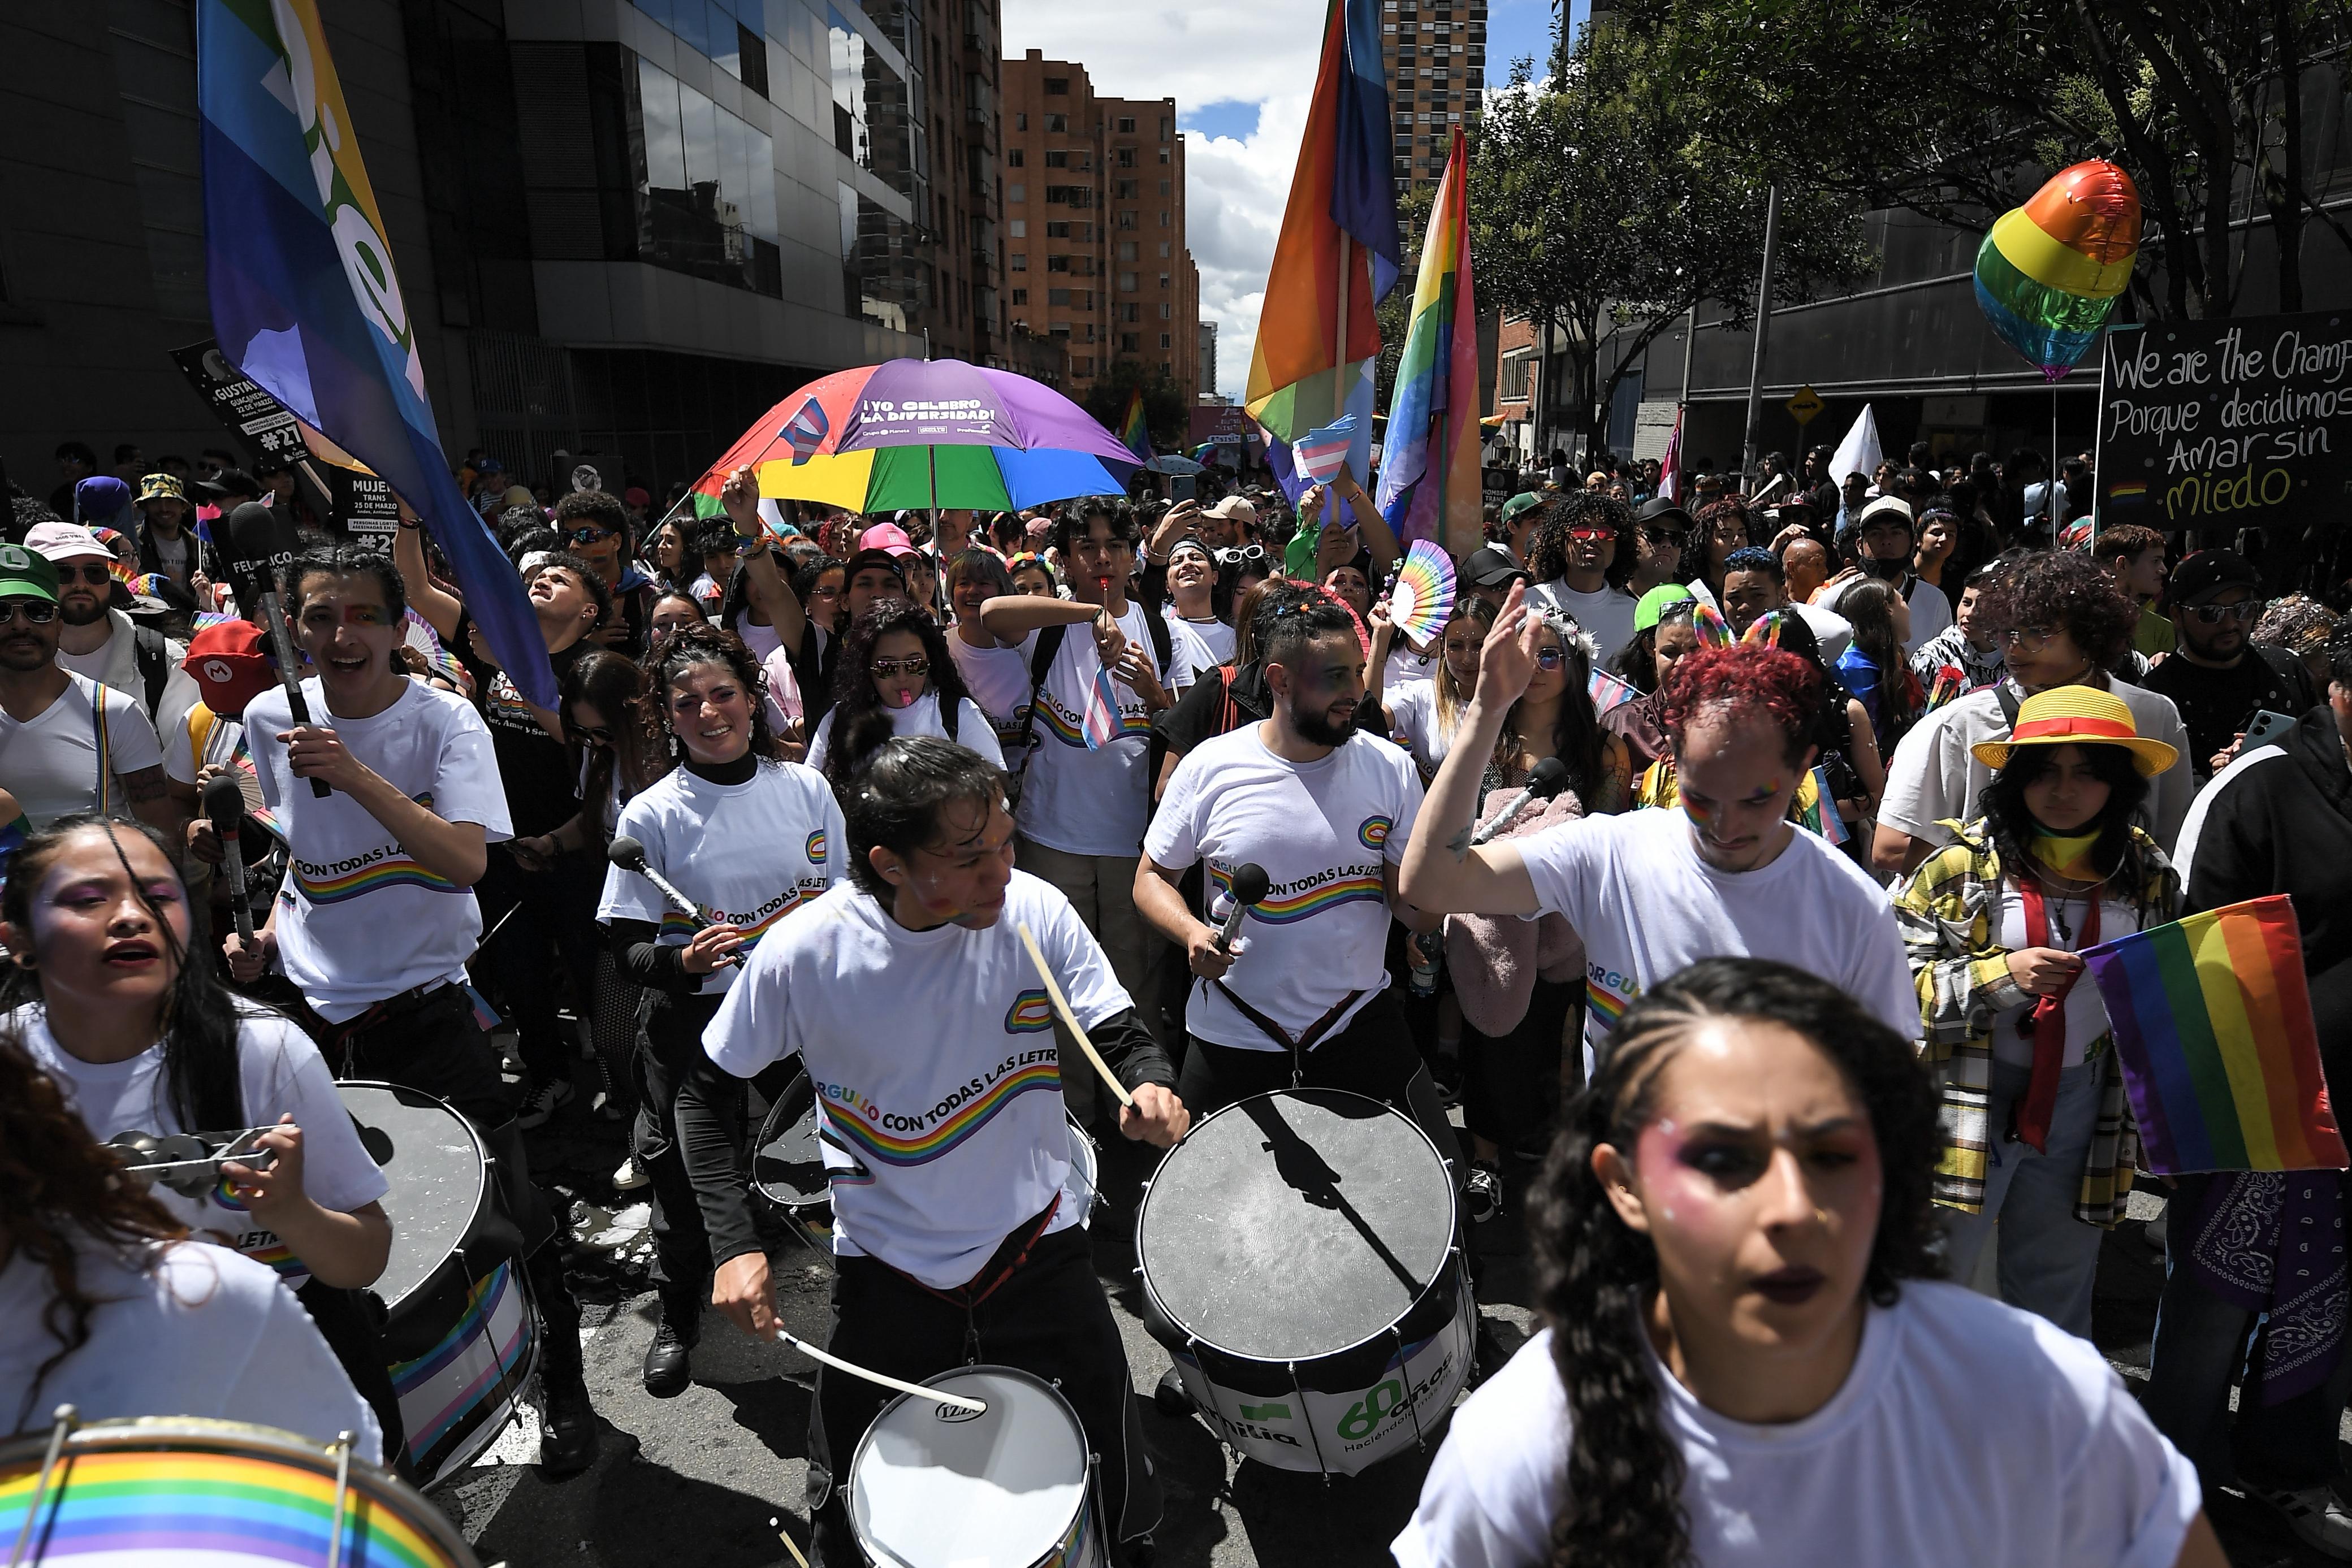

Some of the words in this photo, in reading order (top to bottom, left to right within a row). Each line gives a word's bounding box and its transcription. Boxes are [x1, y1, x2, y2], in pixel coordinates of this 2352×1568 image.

[2109, 331, 2163, 389] We
[2167, 350, 2212, 385] are
[254, 397, 274, 408] MARZO
[860, 412, 884, 423] LA
[887, 409, 995, 422] DIVERSIDAD!
[902, 399, 982, 411] CELEBRO
[2107, 399, 2200, 447] Porque
[2221, 385, 2352, 428] decidimos
[260, 424, 301, 451] #27
[1482, 488, 1508, 497] HOMBRE
[5, 551, 22, 566] L
[210, 664, 228, 678] M
[295, 859, 327, 876] CON
[330, 849, 384, 874] TODAS
[1289, 868, 1335, 893] TODAS
[1338, 865, 1364, 877] LAS
[727, 911, 756, 925] CON
[756, 887, 798, 916] TODAS
[883, 1113, 924, 1132] CON
[924, 1078, 984, 1125] TODAS
[984, 1056, 1015, 1085] LAS
[1337, 1379, 1402, 1440] 60
[1390, 1351, 1452, 1418] años
[941, 1405, 979, 1418] IZZ
